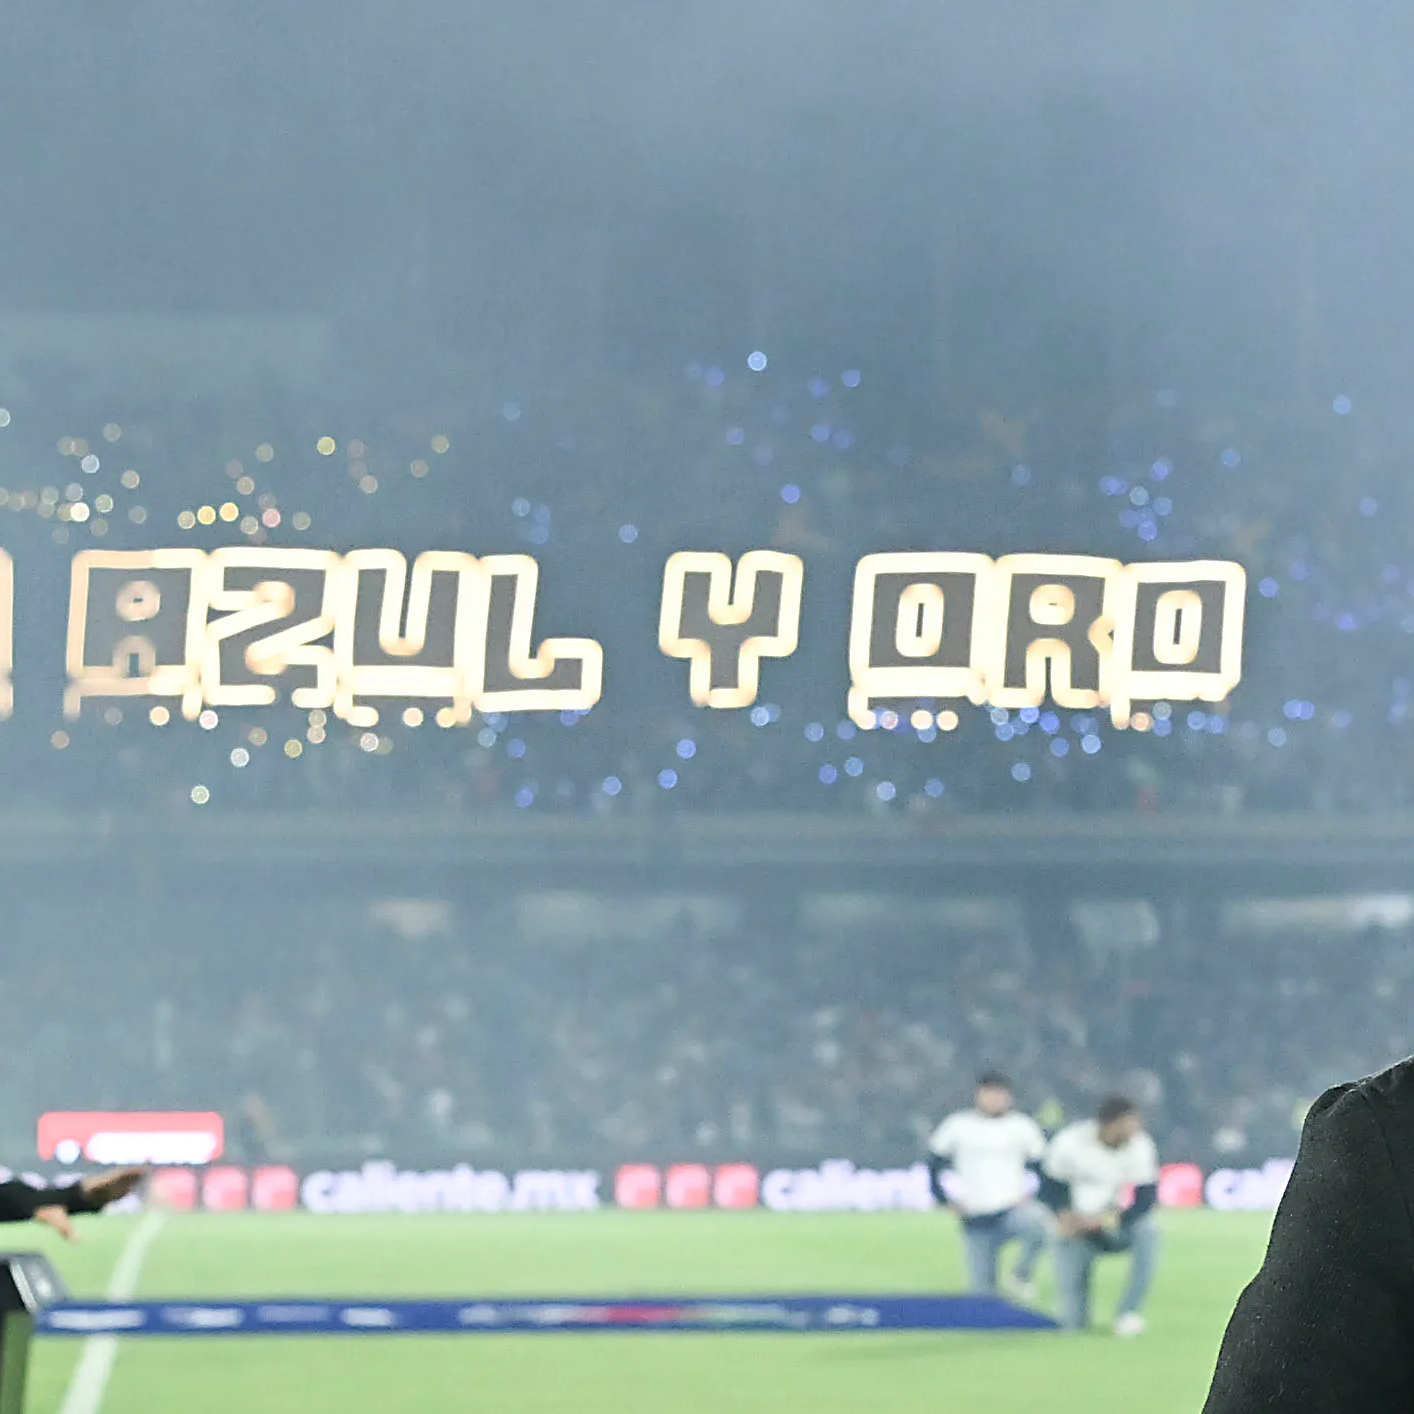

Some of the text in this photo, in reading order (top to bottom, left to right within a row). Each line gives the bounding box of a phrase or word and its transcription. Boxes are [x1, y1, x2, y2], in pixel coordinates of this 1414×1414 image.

[64, 545, 603, 724] AZUL
[658, 548, 804, 708] Y
[848, 550, 1247, 727] ORO
